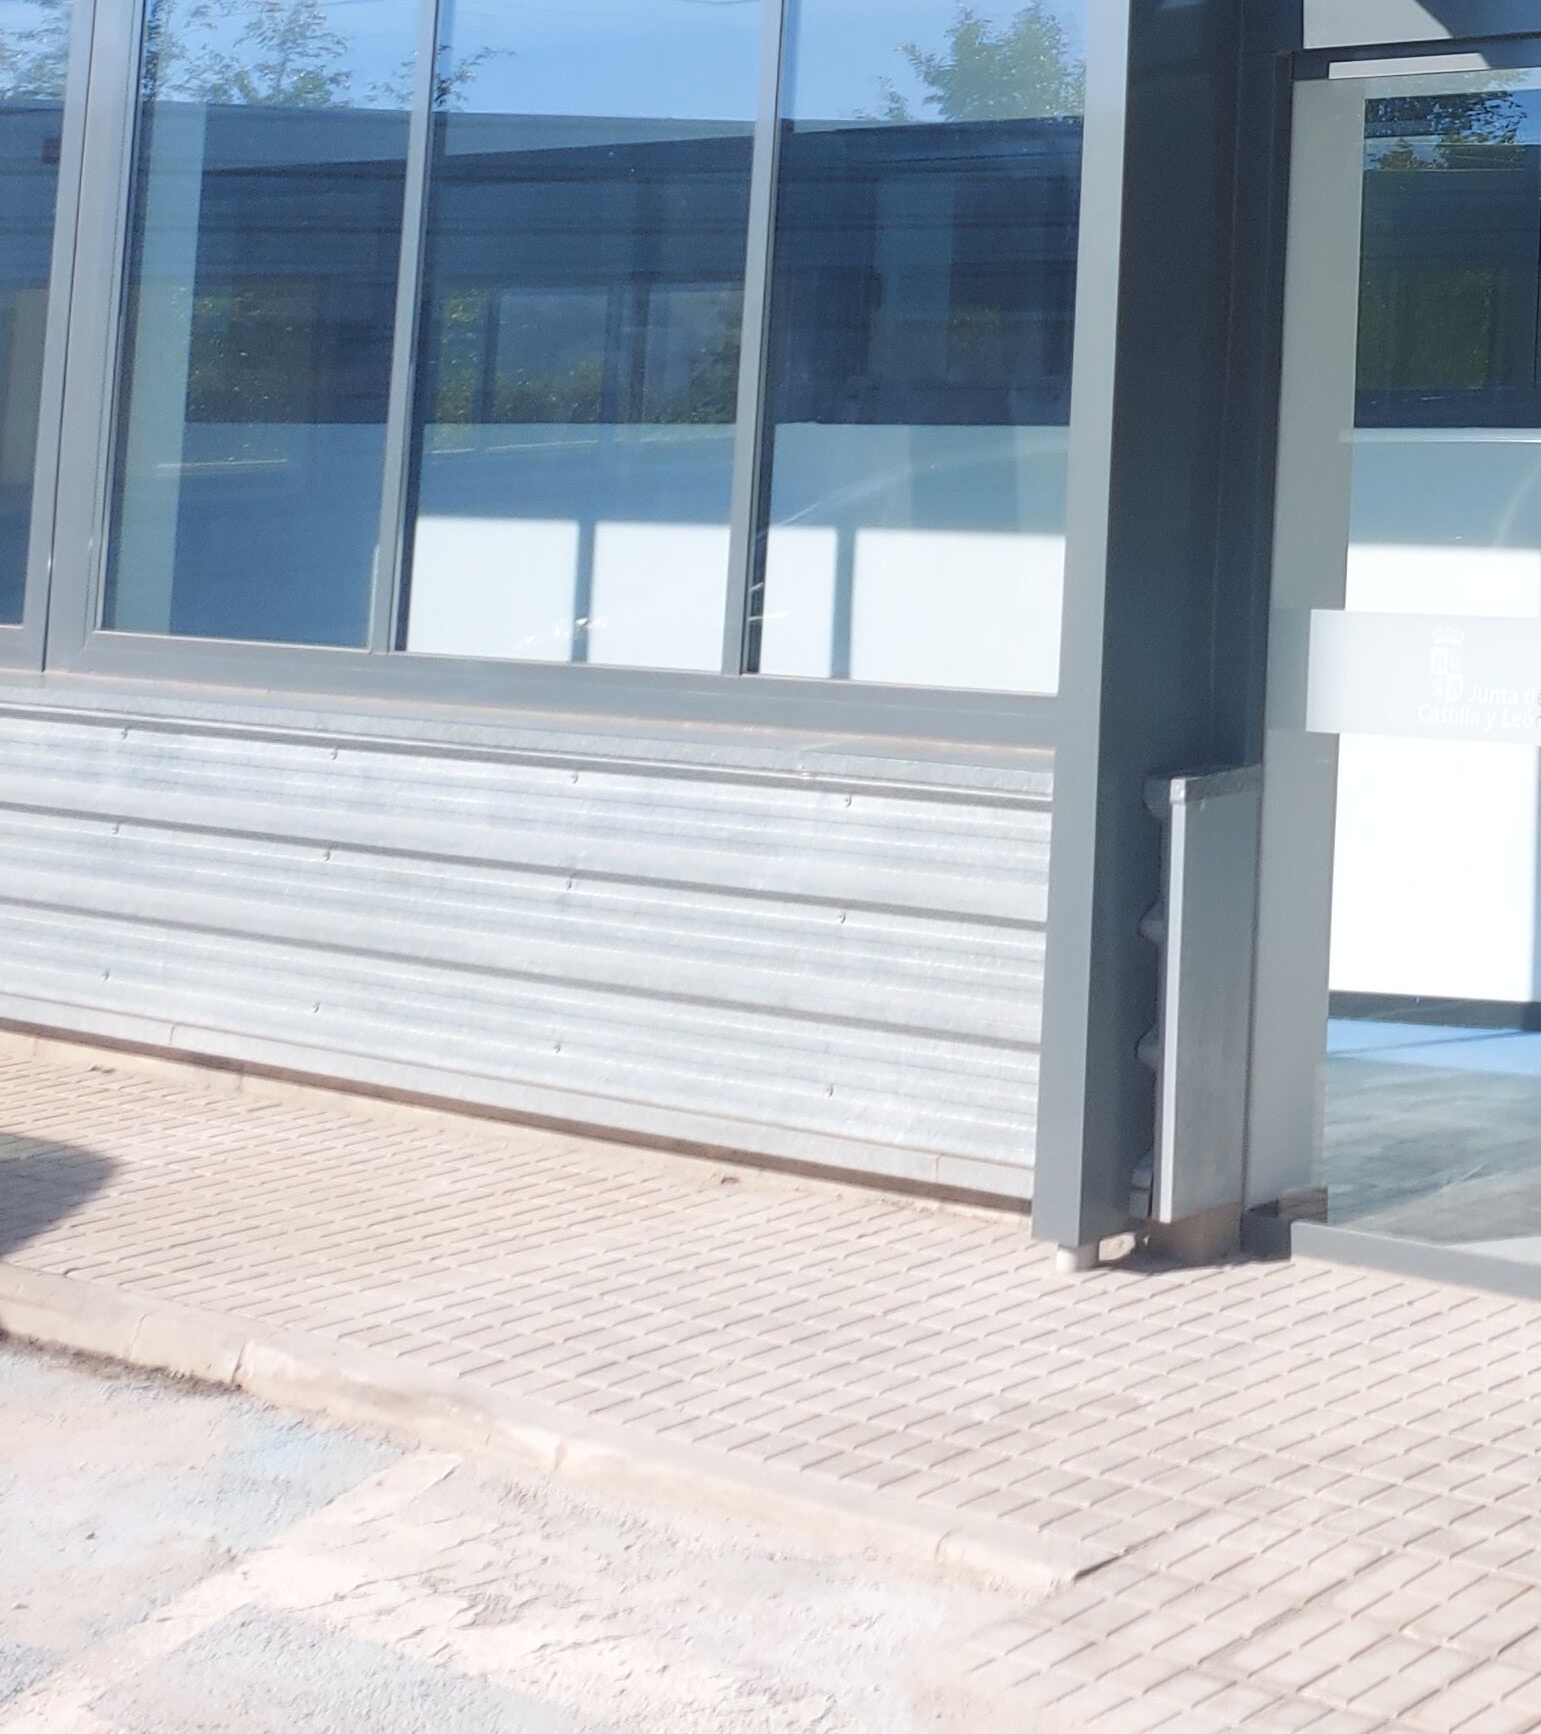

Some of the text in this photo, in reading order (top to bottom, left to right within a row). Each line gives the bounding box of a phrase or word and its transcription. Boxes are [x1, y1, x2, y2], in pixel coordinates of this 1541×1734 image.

[1467, 683, 1521, 706] Junta
[1417, 703, 1480, 726] Castilla
[1481, 710, 1497, 732] y
